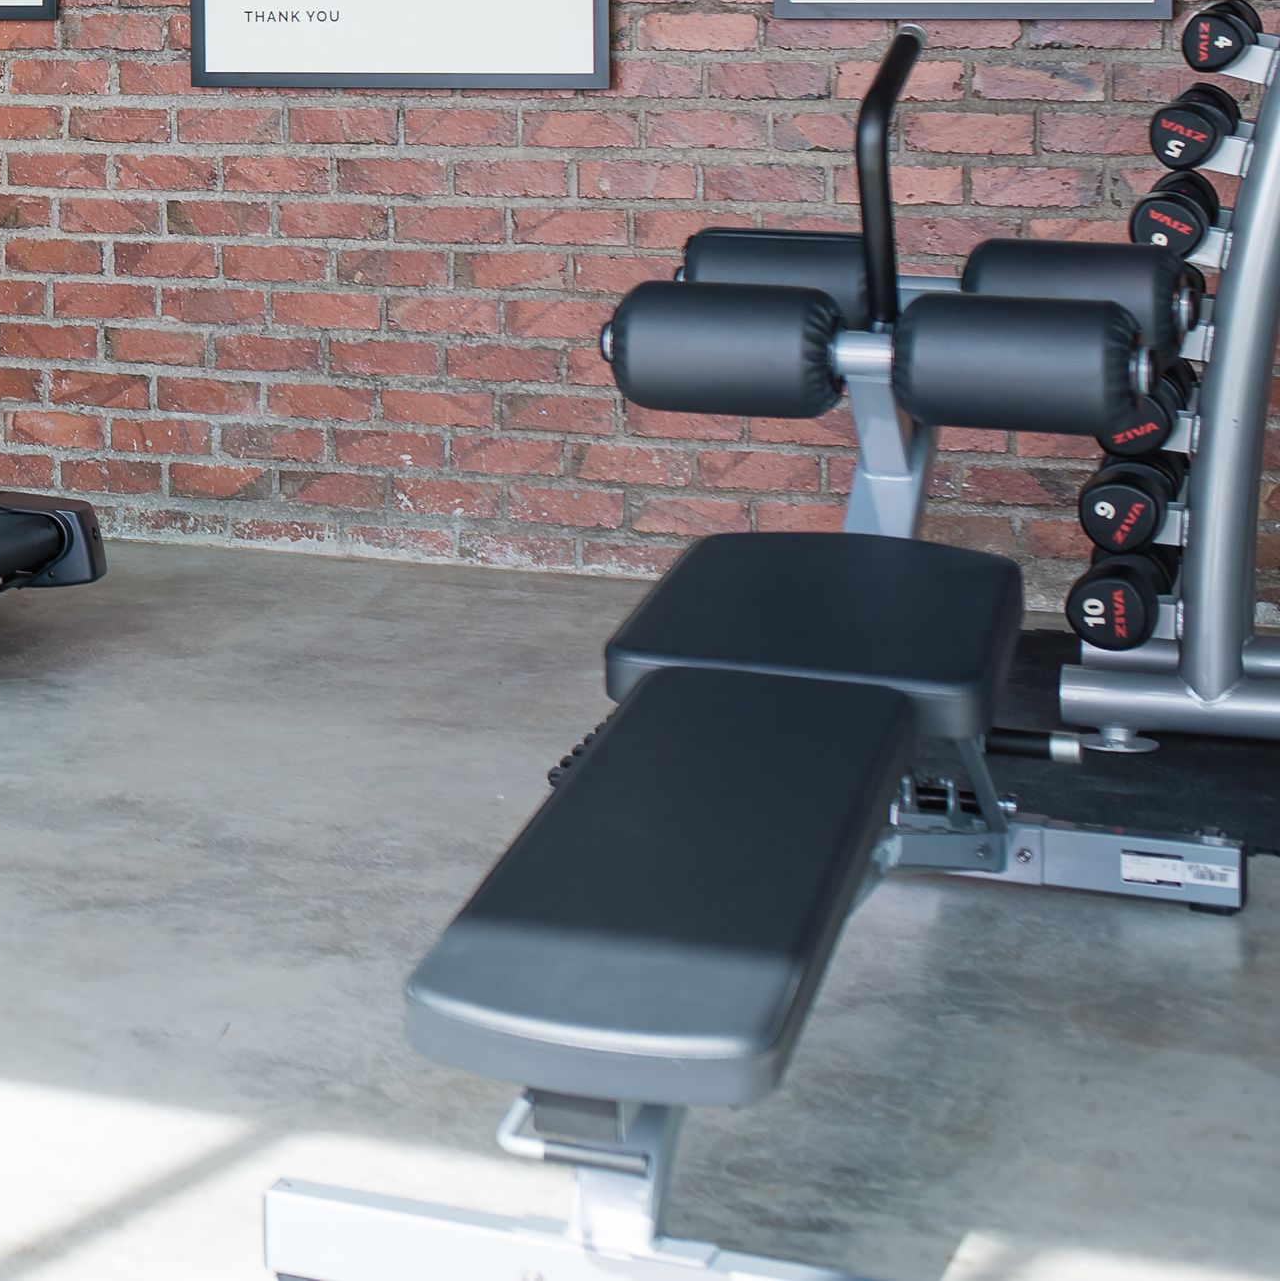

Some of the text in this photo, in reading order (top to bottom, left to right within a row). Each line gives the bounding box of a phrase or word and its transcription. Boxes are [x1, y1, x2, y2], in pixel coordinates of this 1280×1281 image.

[243, 10, 339, 22] THANK YOU
[1198, 22, 1210, 62] ZIVA
[1213, 35, 1233, 49] 4
[1160, 118, 1208, 143] ZIVA
[1164, 139, 1186, 159] 5
[1149, 209, 1193, 235] ZIVA
[1112, 422, 1160, 445] ZIVA
[1094, 501, 1116, 519] 9
[1112, 502, 1146, 546] ZIVA
[1082, 598, 1106, 627] 10
[1112, 589, 1128, 638] ZIVA
